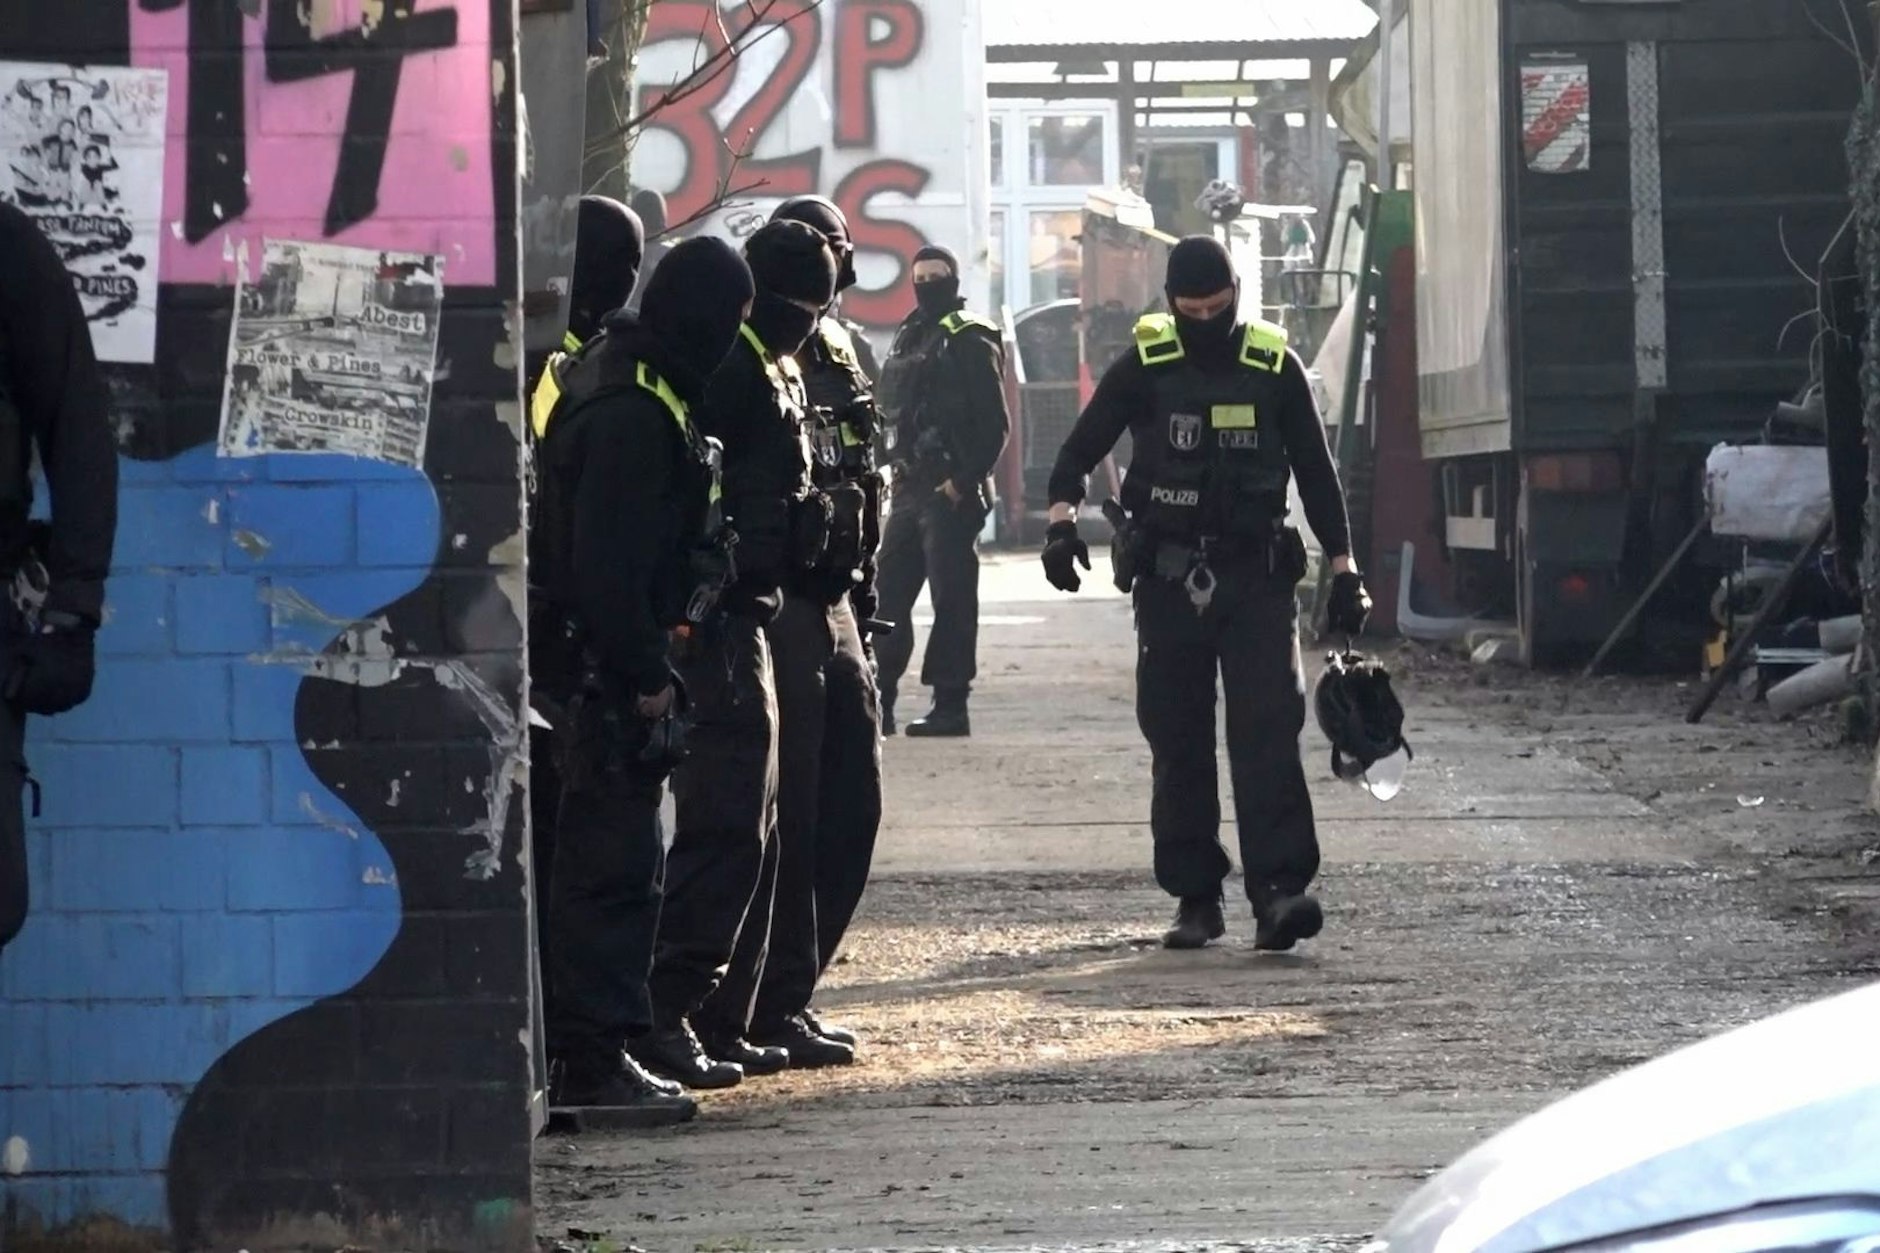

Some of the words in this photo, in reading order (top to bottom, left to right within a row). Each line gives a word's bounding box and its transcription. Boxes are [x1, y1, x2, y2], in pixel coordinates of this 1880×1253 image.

[360, 306, 422, 331] Abest
[237, 350, 301, 366] Flower
[328, 355, 382, 373] Pines
[285, 407, 373, 430] Crowskin
[1151, 486, 1199, 506] POLIZEI
